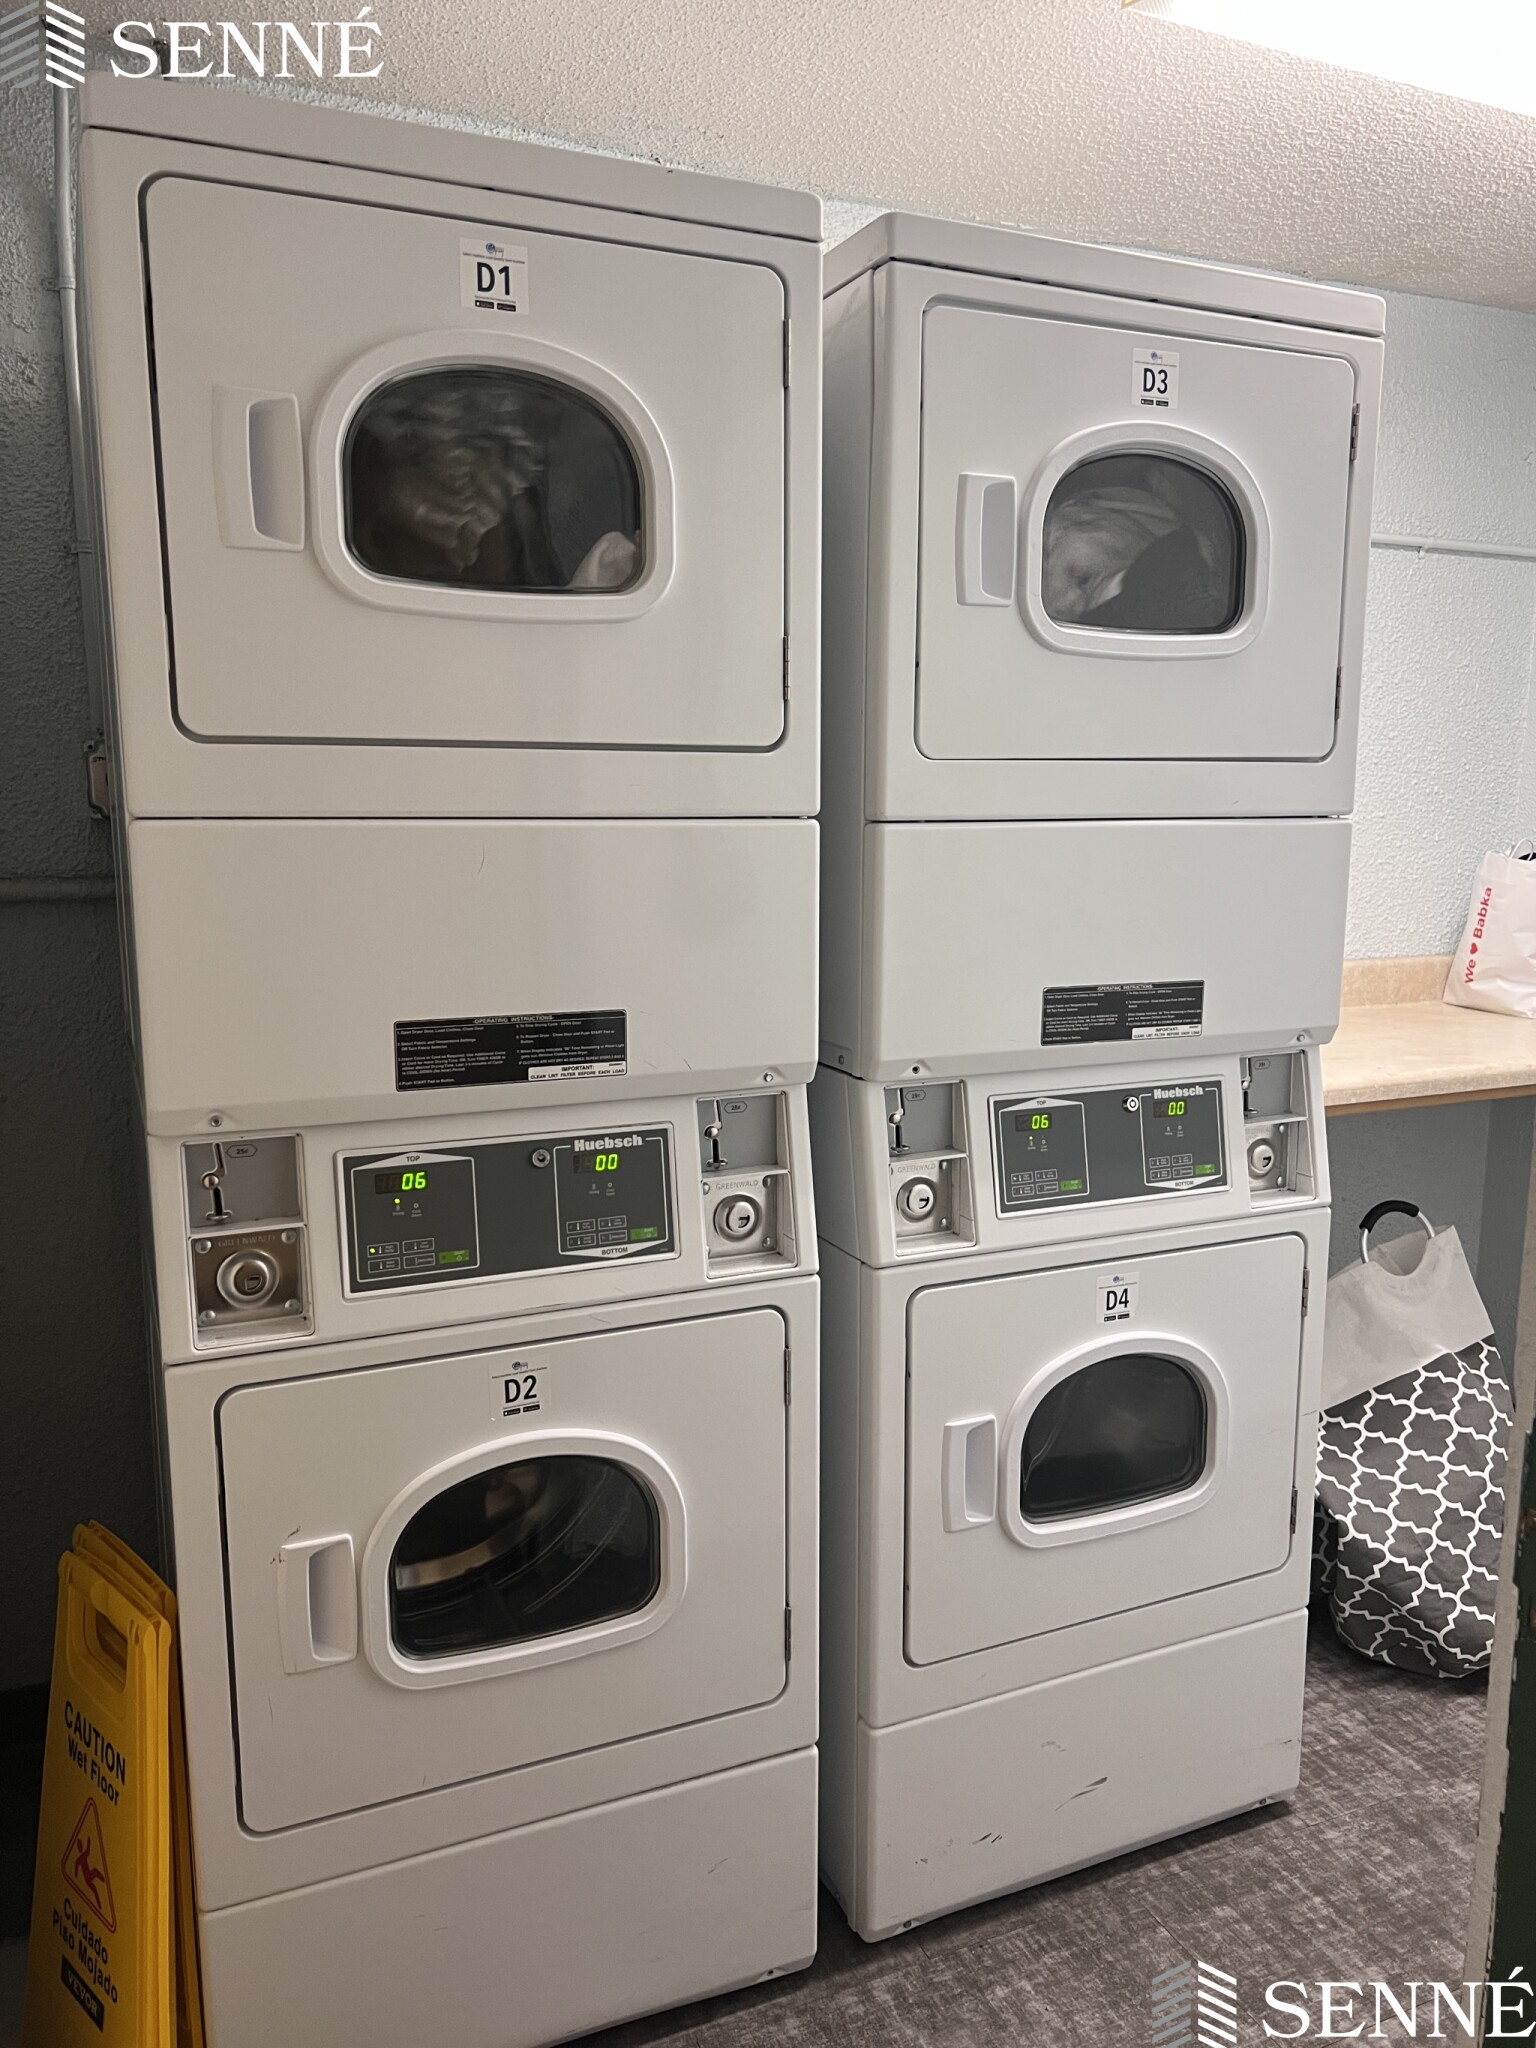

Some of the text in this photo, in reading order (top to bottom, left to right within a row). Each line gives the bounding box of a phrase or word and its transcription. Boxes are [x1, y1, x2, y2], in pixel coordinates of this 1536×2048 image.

[477, 261, 510, 296] D1
[1143, 367, 1168, 394] D3
[1465, 887, 1492, 984] We Babka
[1153, 1085, 1204, 1100] Huebsch
[1168, 1101, 1185, 1116] 00
[1031, 1114, 1049, 1130] 06
[574, 1134, 643, 1152] Huebsch
[406, 1155, 420, 1163] TOP
[595, 1153, 618, 1171] 00
[401, 1171, 426, 1191] 06
[601, 1246, 628, 1255] BOTTOM
[1106, 1287, 1130, 1311] D4
[504, 1374, 537, 1404] D2
[64, 1700, 126, 1787] CAUTION
[68, 1733, 119, 1806] Wet Floor
[63, 1897, 108, 1965] Cuidado
[53, 1906, 118, 2003] Piso Mojado
